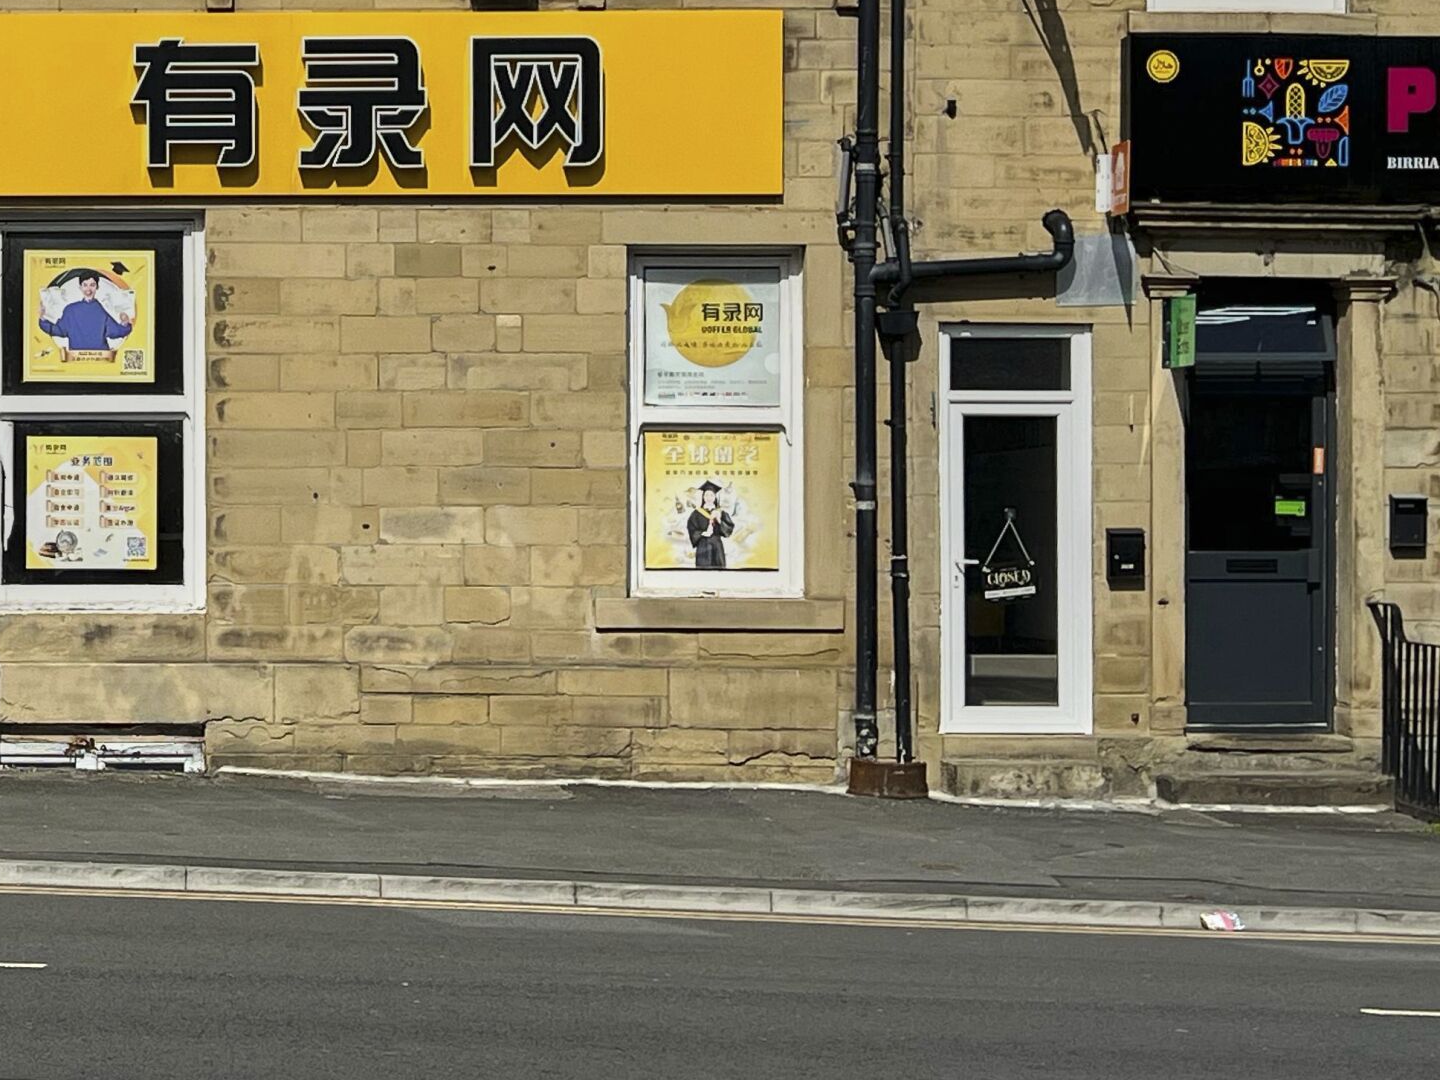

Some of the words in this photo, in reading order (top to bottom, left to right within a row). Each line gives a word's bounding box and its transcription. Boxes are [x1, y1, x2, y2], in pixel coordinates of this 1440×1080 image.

[133, 35, 604, 168] 有录网
[1387, 67, 1437, 133] P
[1387, 155, 1440, 170] BIRRIA
[701, 302, 764, 322] 有录网
[733, 326, 763, 334] GLOBAL
[987, 569, 1031, 587] CLOSED
